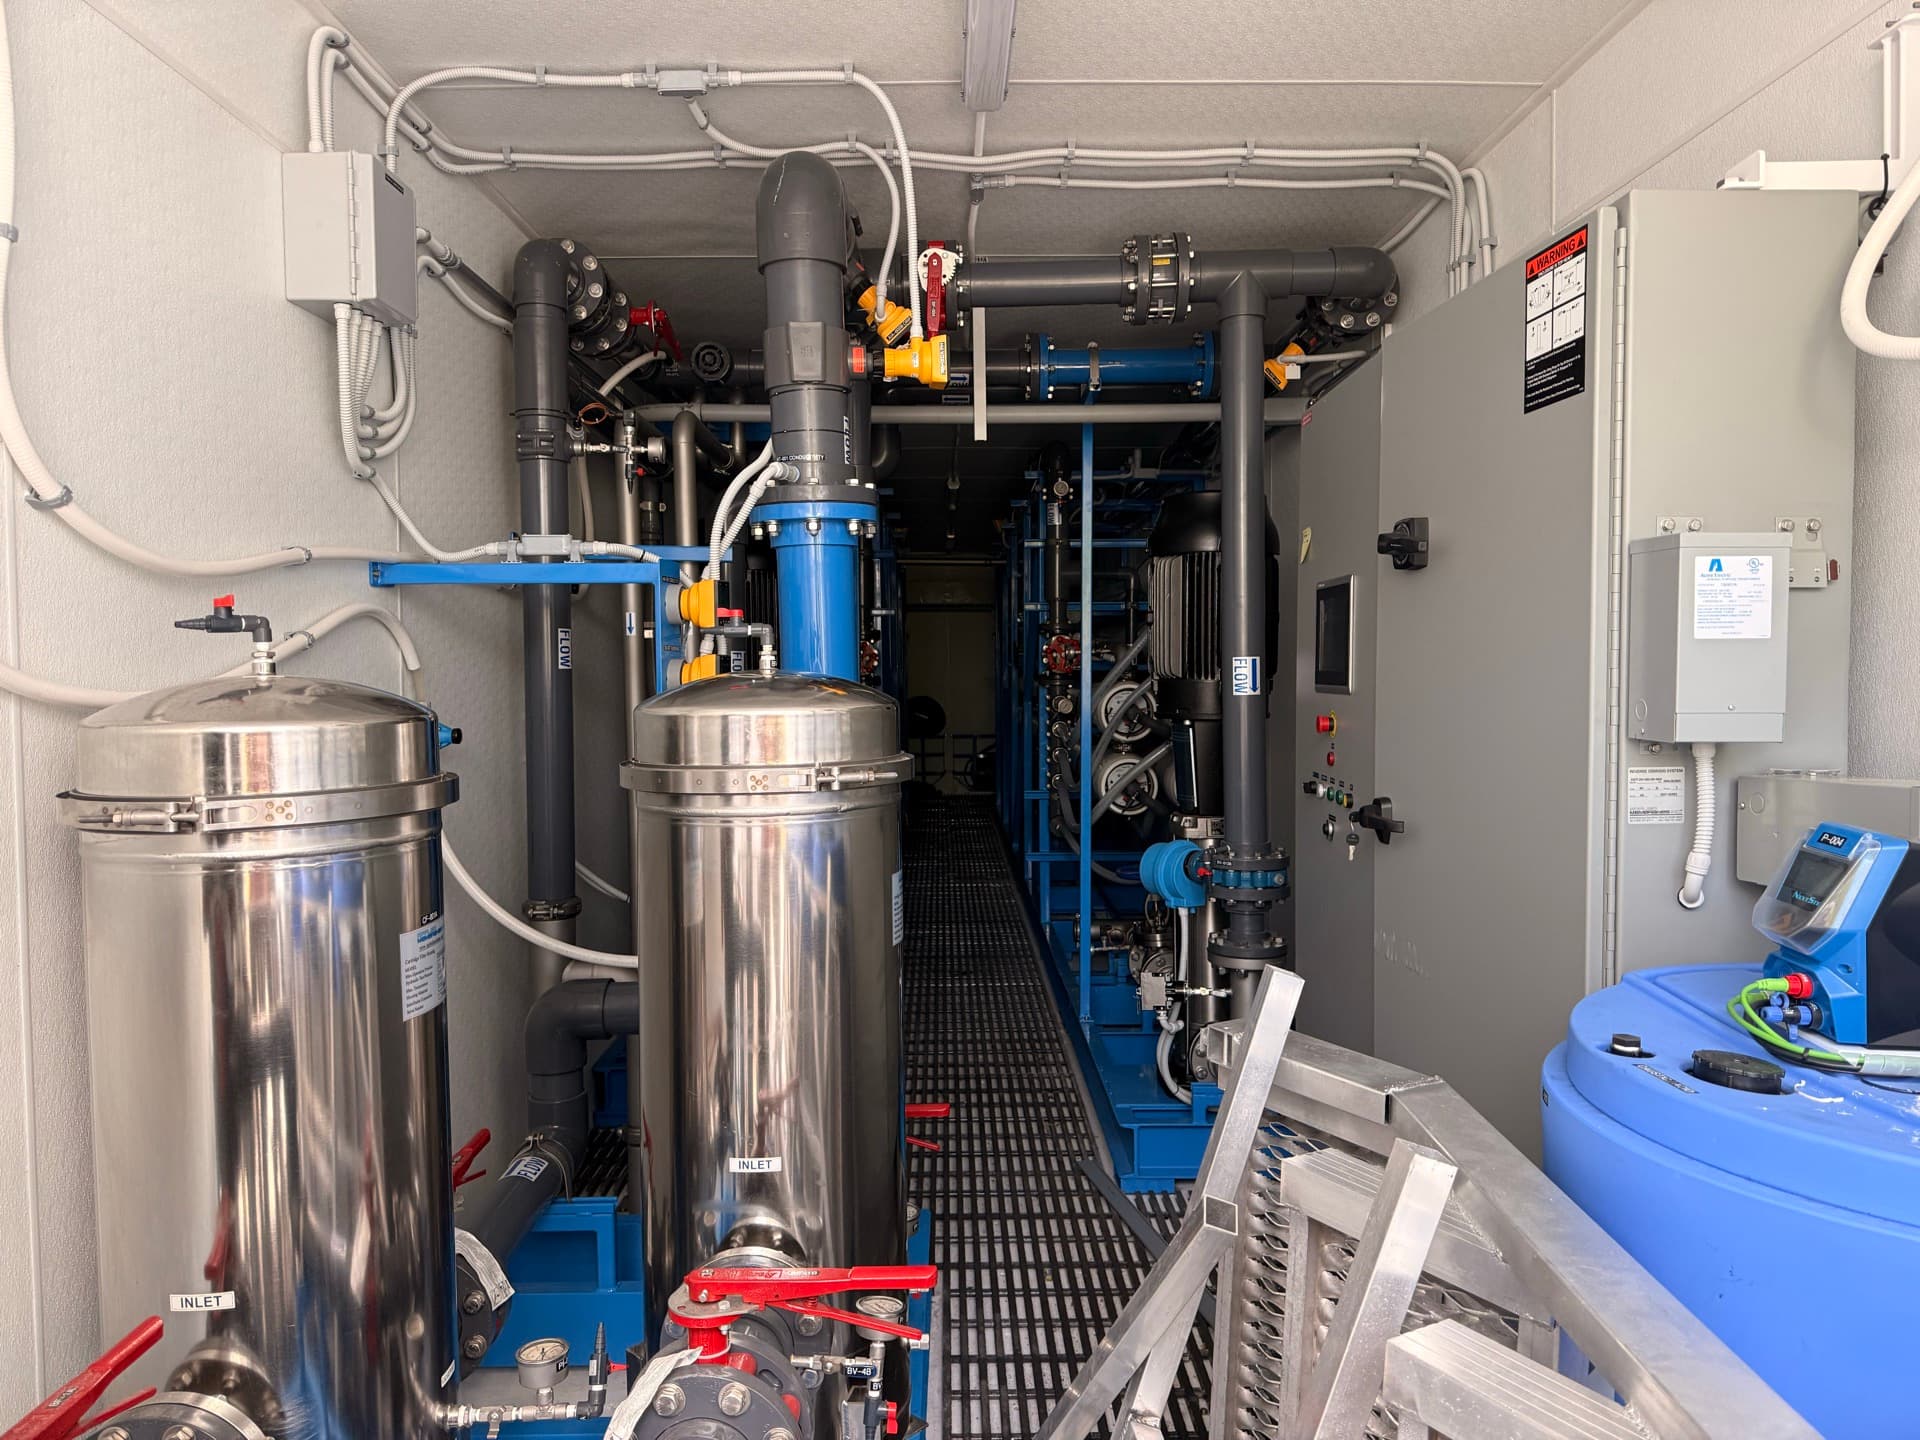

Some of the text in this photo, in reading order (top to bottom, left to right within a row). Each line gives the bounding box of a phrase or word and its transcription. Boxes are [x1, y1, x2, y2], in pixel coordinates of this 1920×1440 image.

[1536, 239, 1576, 270] WARNING
[560, 630, 571, 668] FLOW
[732, 652, 743, 671] FLO
[1234, 658, 1248, 694] FLOW
[1820, 833, 1845, 847] P-004
[517, 1157, 547, 1180] FLOW
[738, 1160, 772, 1170] INLET
[180, 1295, 222, 1309] INLET
